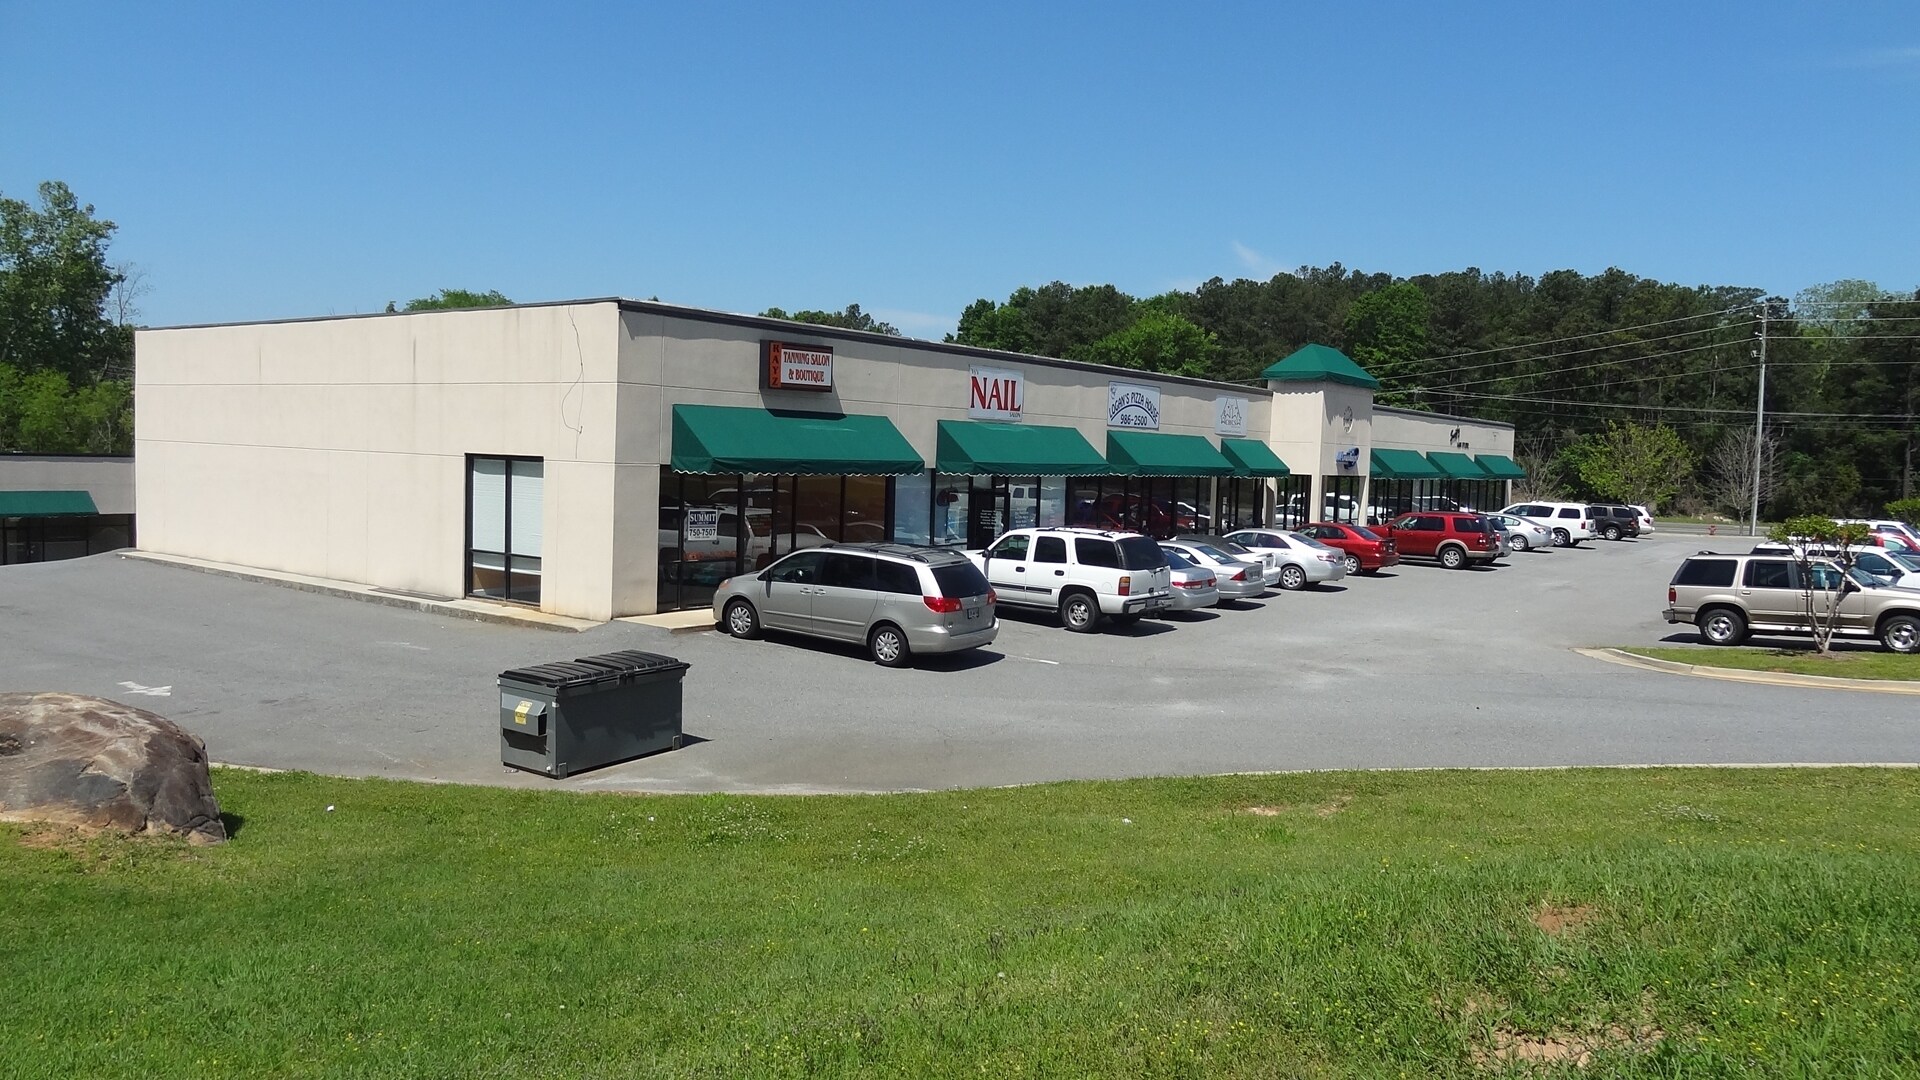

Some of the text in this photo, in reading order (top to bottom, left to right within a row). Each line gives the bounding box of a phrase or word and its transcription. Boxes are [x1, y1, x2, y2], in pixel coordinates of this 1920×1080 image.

[784, 351, 830, 367] TANNING SALON
[788, 369, 825, 383] & BOUTIQUE
[970, 376, 1021, 411] NAIL
[1108, 391, 1160, 423] LOGAN'S PIZZA HOUSE
[1120, 414, 1148, 426] 986-2500
[690, 513, 716, 522] SUMMIT
[690, 528, 716, 537] 750-7507
